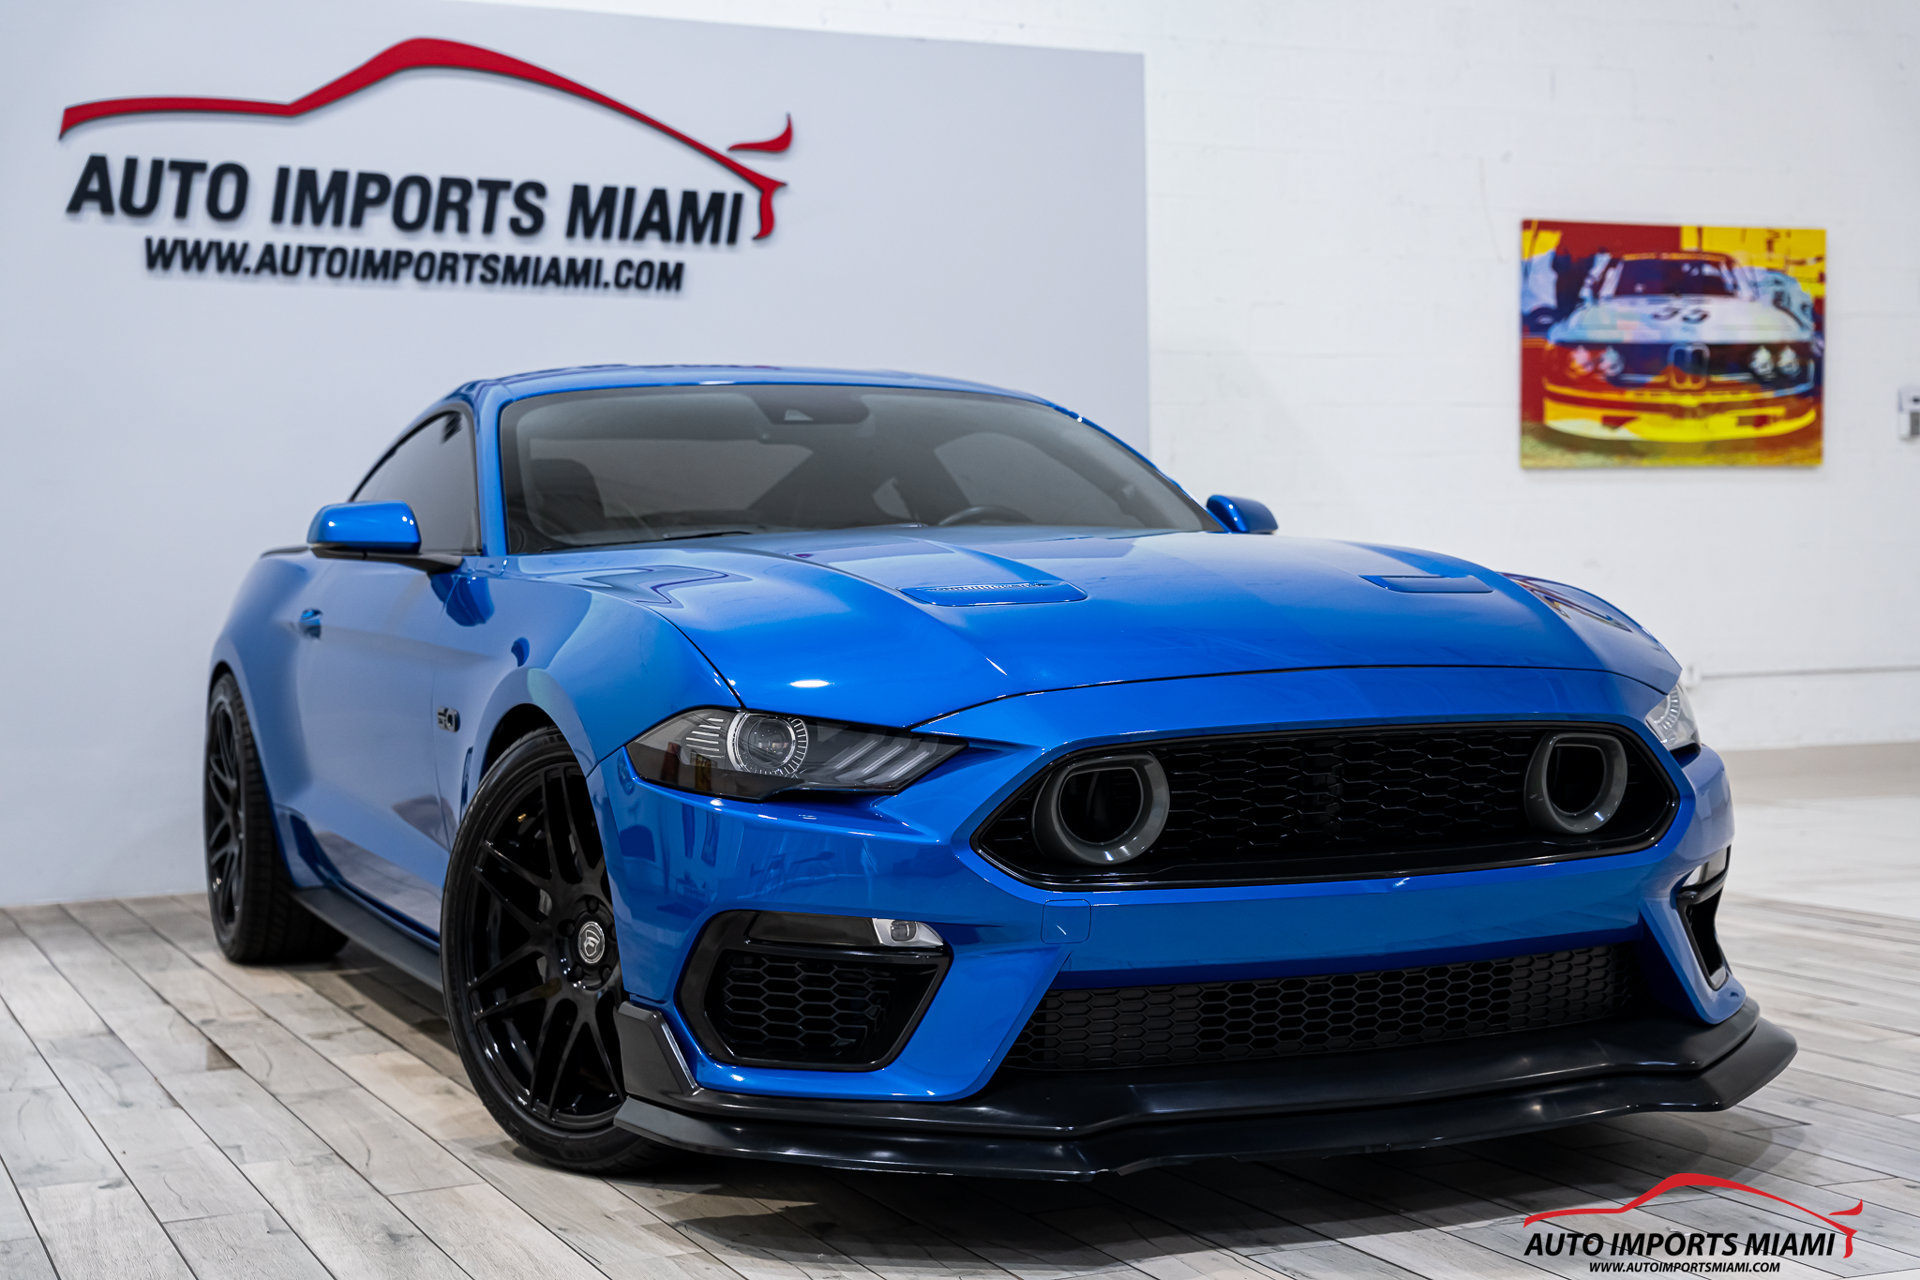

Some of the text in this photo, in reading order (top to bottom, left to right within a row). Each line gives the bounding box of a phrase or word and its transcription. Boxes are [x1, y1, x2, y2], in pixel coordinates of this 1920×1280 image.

[66, 154, 744, 246] AUTO IMPORTS MIAMI
[145, 236, 685, 291] WWW.AUTOIMPORTSMIAMI.COM
